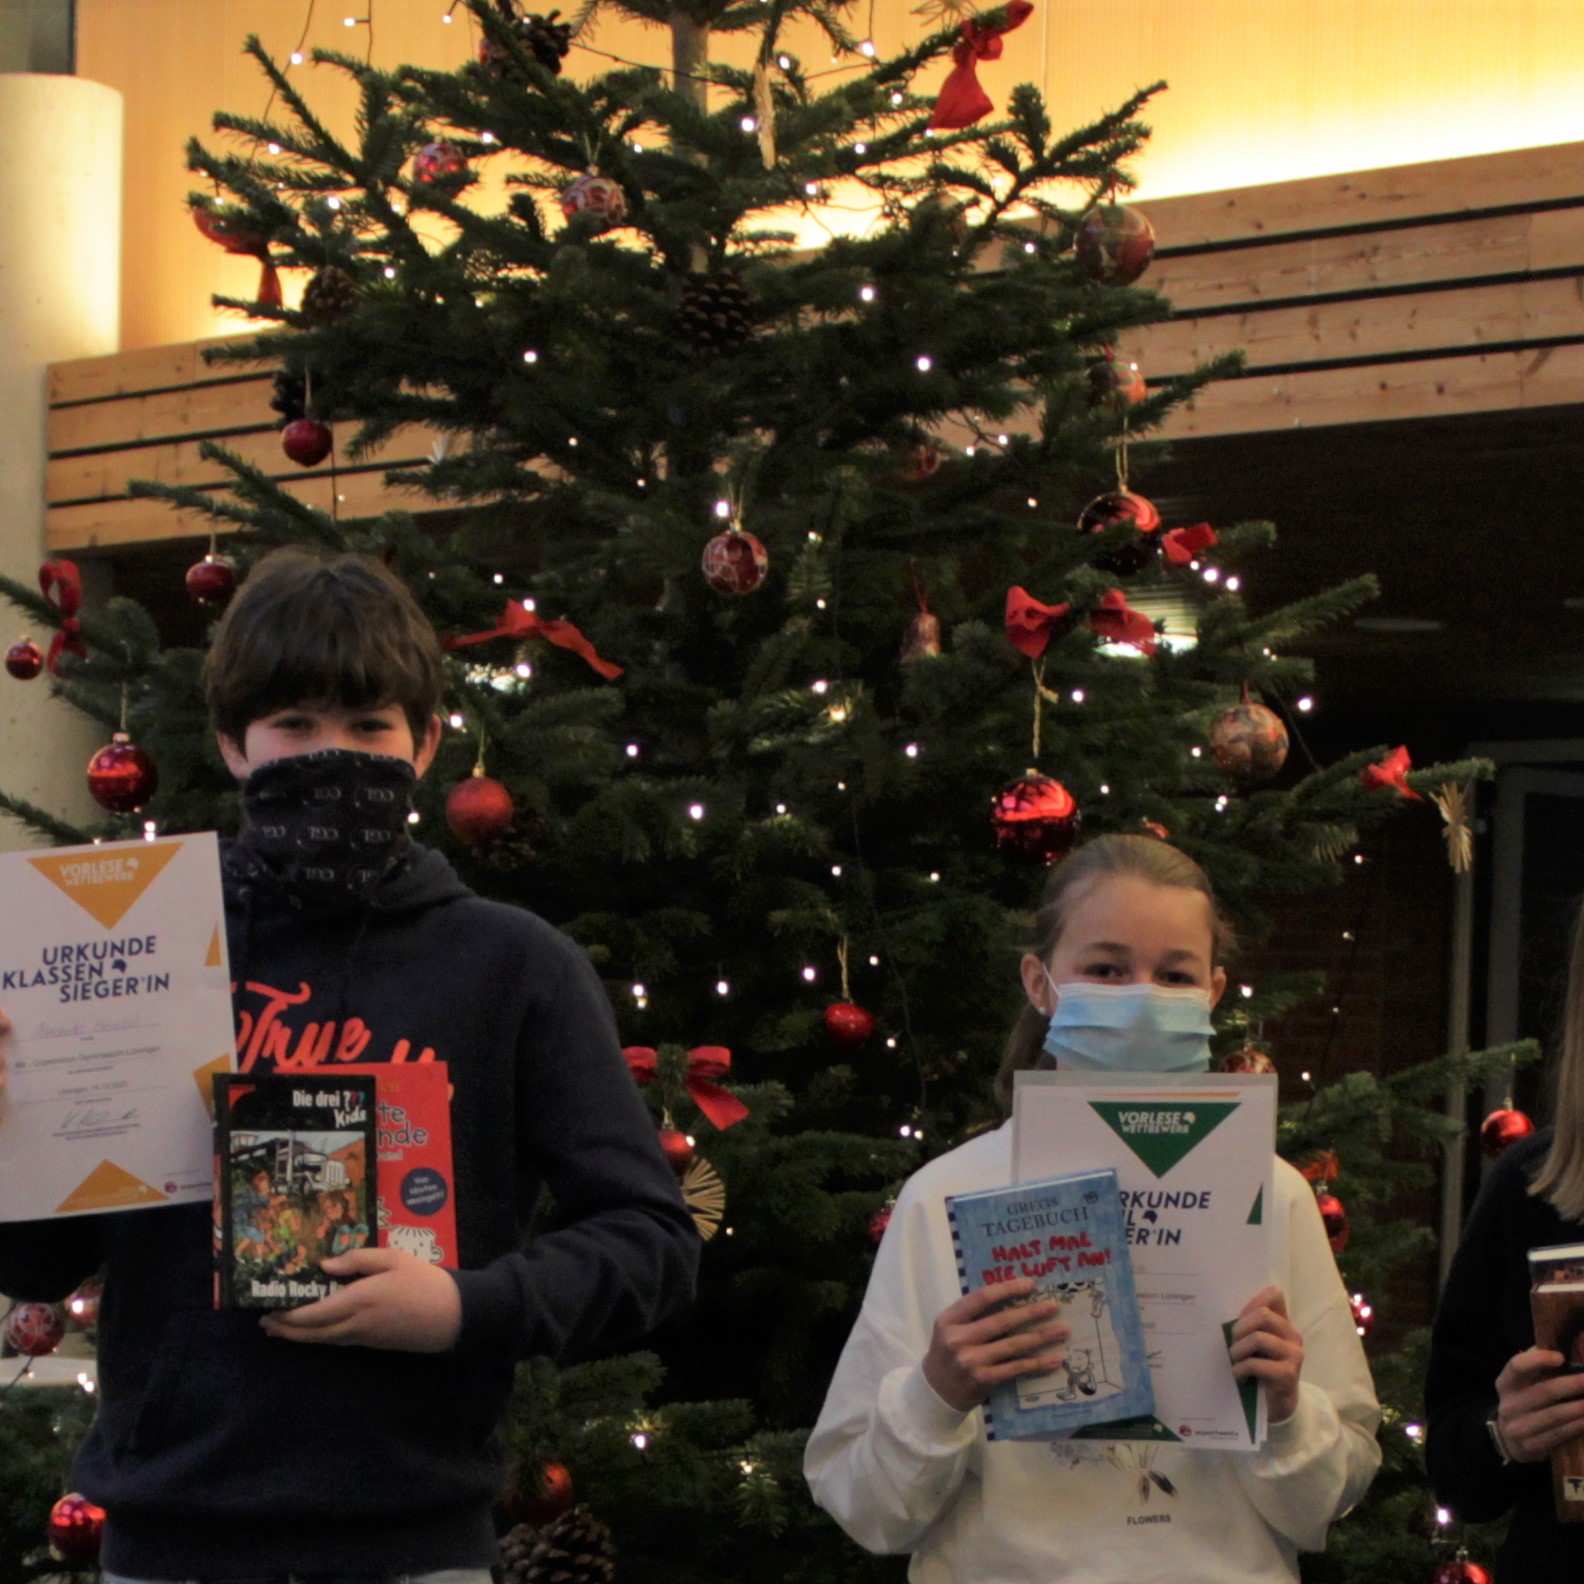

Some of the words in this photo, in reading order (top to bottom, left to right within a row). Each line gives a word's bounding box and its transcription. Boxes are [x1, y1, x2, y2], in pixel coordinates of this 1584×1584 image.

[59, 858, 125, 877] VORLESE
[42, 935, 157, 966] URKUNDE
[2, 960, 104, 991] KLASSEN
[292, 1089, 313, 1107] Die
[315, 1089, 341, 1107] drei
[333, 1104, 367, 1129] Kids
[377, 1101, 405, 1124] te
[1118, 1110, 1182, 1125] VORLESE
[377, 1119, 427, 1146] nde
[1122, 1122, 1191, 1134] WETTBEWERB
[1007, 1196, 1059, 1215] GREGS
[1119, 1191, 1213, 1210] RKUNDE
[982, 1206, 1089, 1237] TAGEBUCH
[992, 1239, 1042, 1263] HALT
[1049, 1231, 1093, 1251] MAL
[982, 1265, 1017, 1286] DIE
[1021, 1256, 1071, 1278] LUFT
[250, 1279, 287, 1297] Radio
[289, 1279, 327, 1300] Rocky
